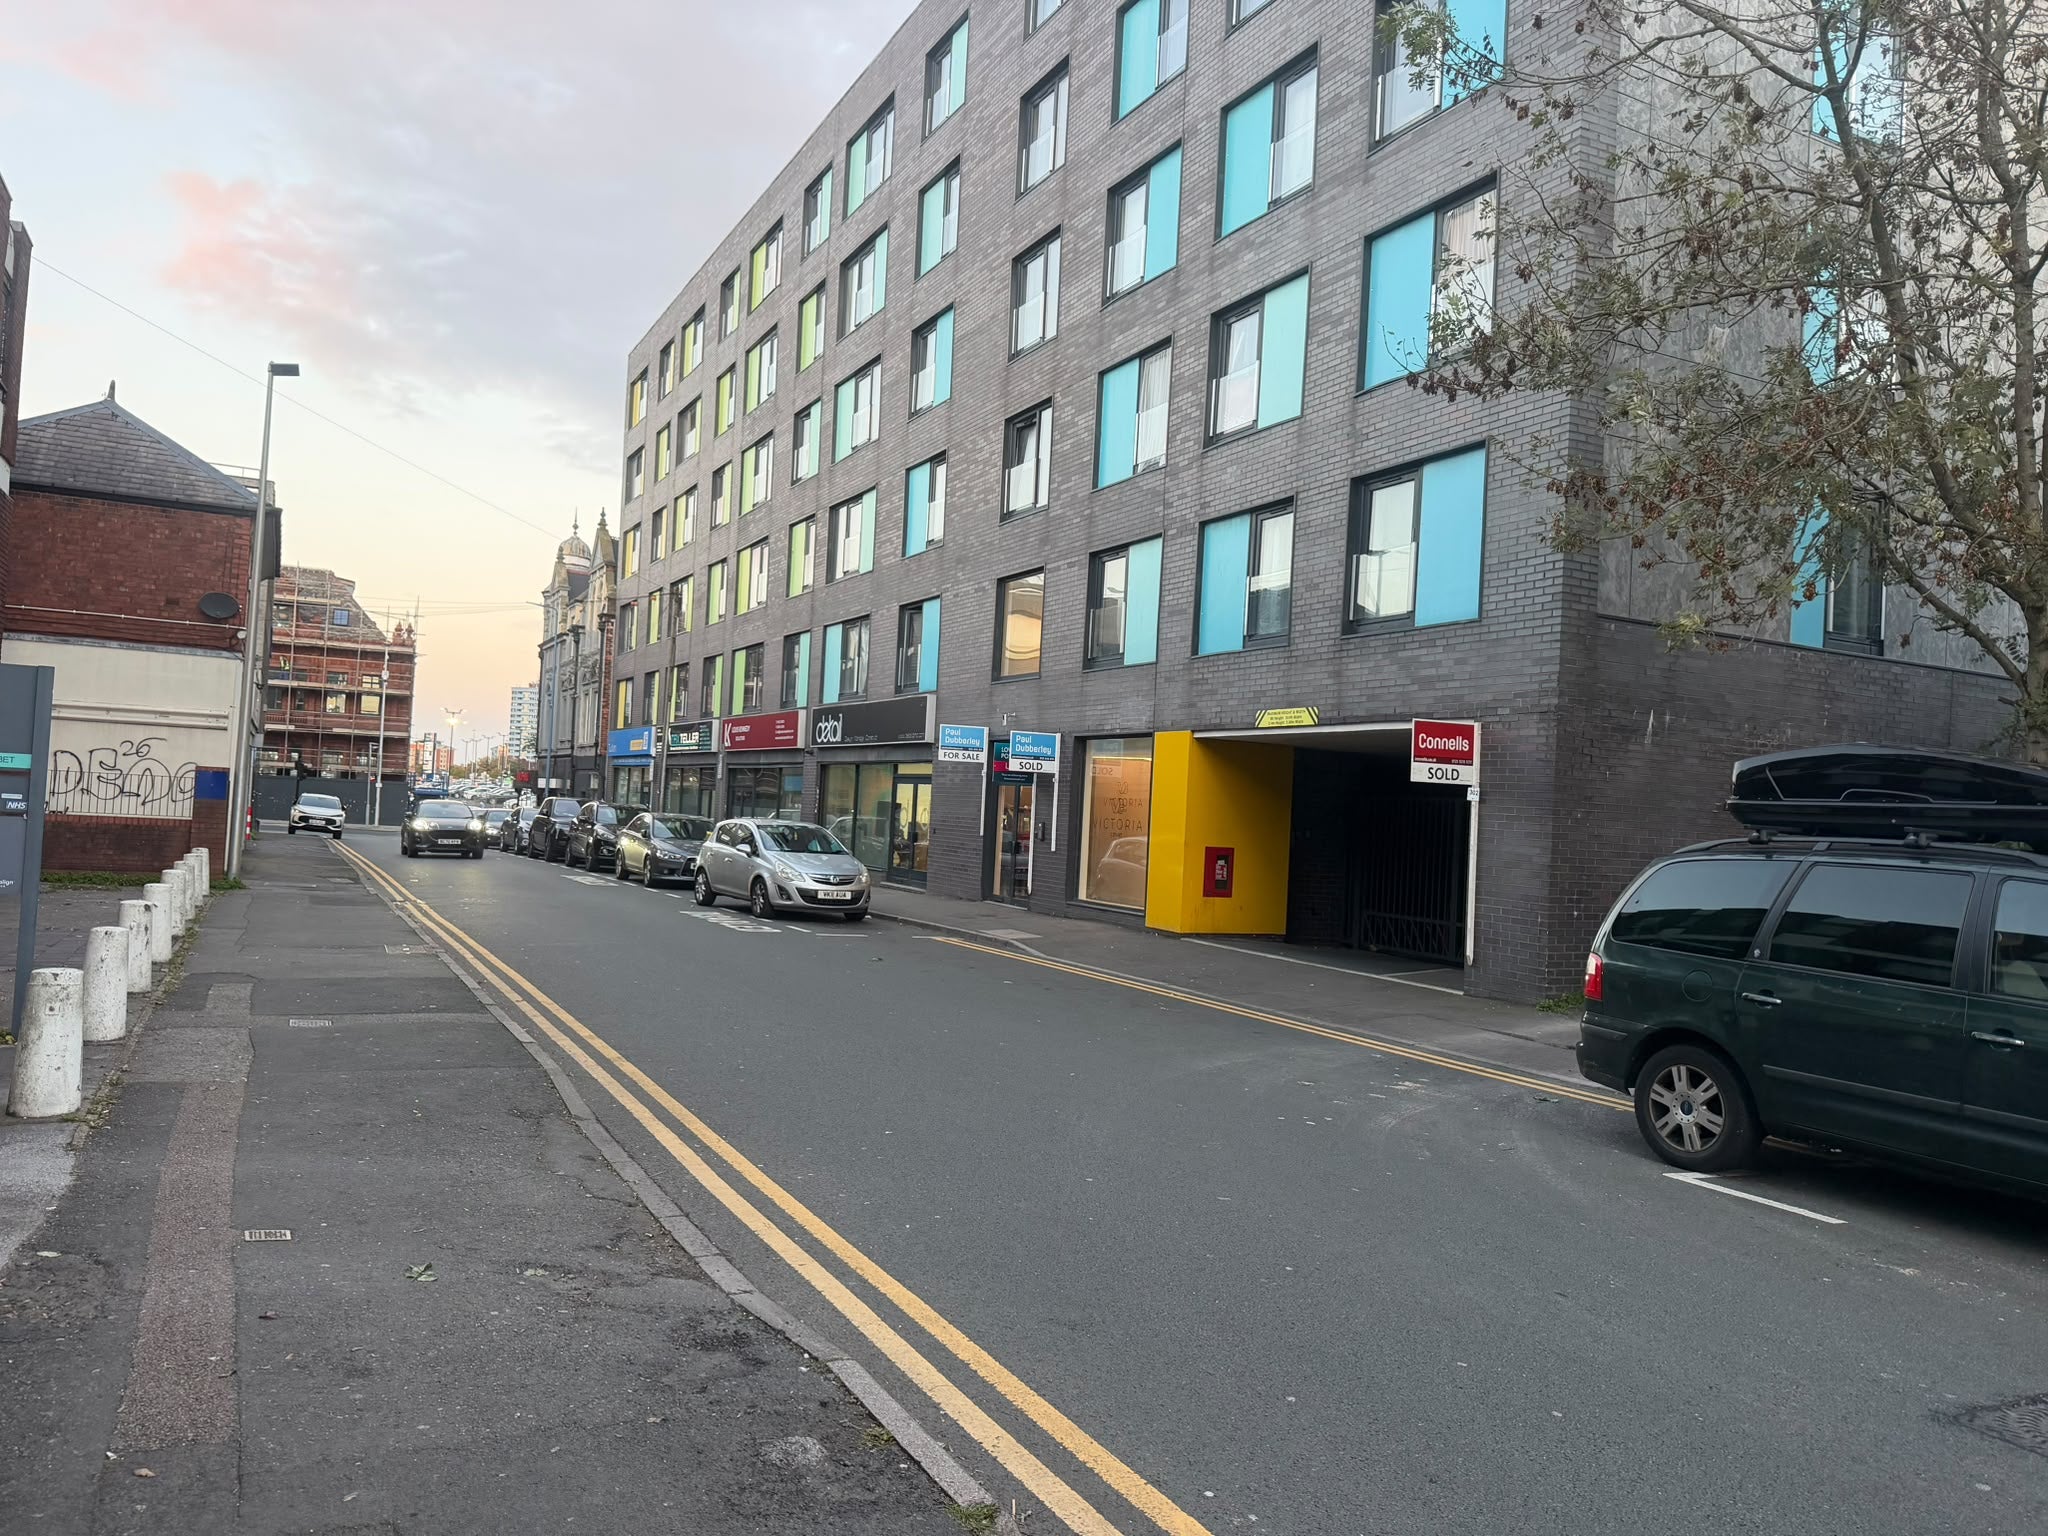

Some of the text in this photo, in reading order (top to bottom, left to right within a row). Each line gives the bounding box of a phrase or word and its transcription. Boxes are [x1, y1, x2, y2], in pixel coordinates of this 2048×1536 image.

[945, 727, 961, 736] Paul
[945, 736, 980, 747] Dubberley
[1015, 734, 1032, 743] Paul
[1418, 733, 1470, 752] Connells
[1015, 743, 1052, 755] Dubberley
[943, 751, 980, 761] FOR SALE
[1019, 761, 1043, 771] SOLD
[1427, 767, 1460, 781] SOLD
[7, 801, 27, 810] NHS
